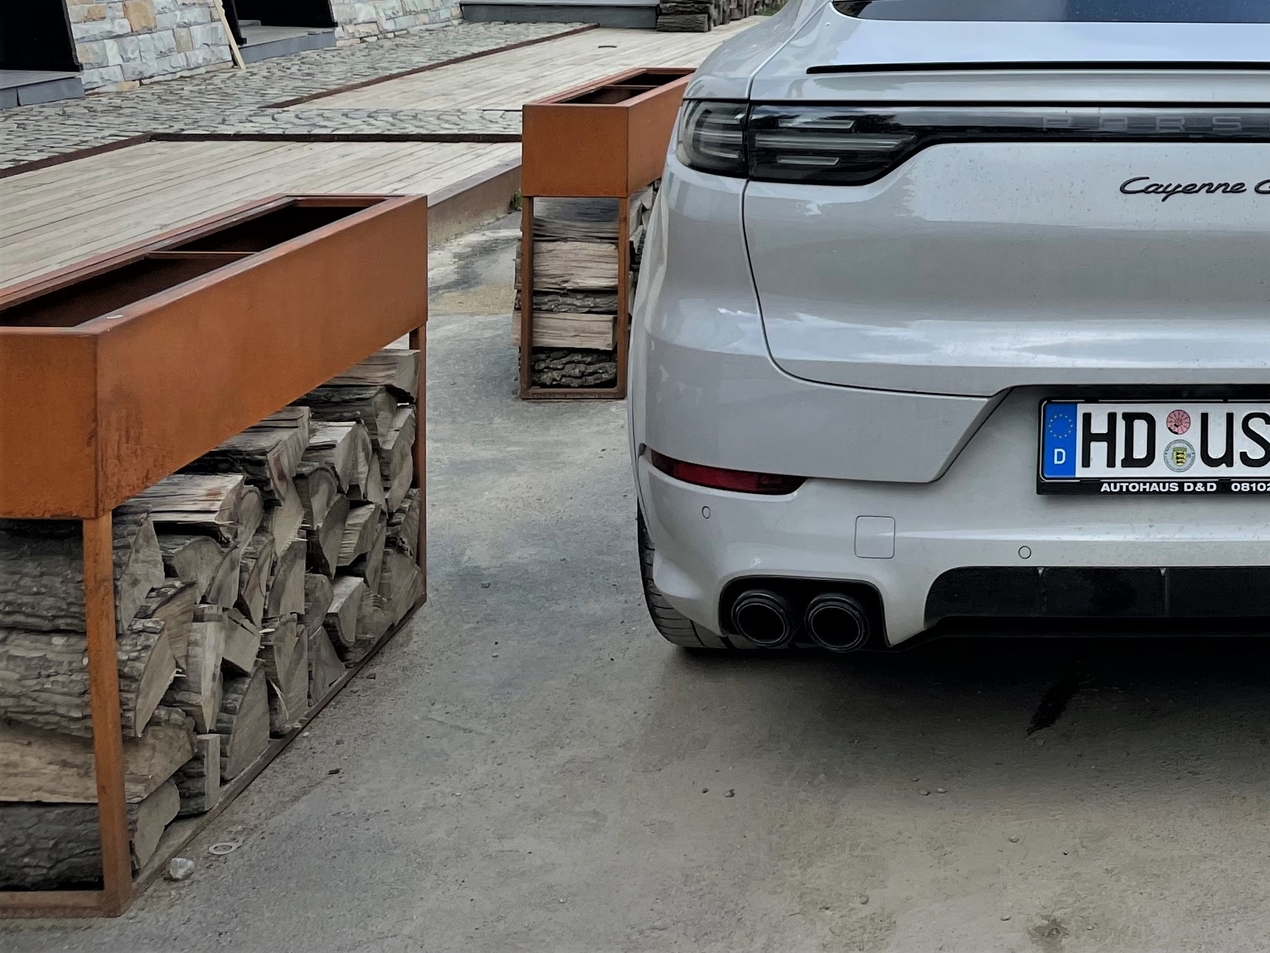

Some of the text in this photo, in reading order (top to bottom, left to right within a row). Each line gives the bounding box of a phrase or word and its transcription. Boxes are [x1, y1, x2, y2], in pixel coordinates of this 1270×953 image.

[1119, 176, 1247, 202] Cayenne
[1081, 411, 1156, 468] HD
[1053, 449, 1066, 465] D
[1100, 482, 1179, 493] AUTOHAUS
[1184, 482, 1217, 493] D&D
